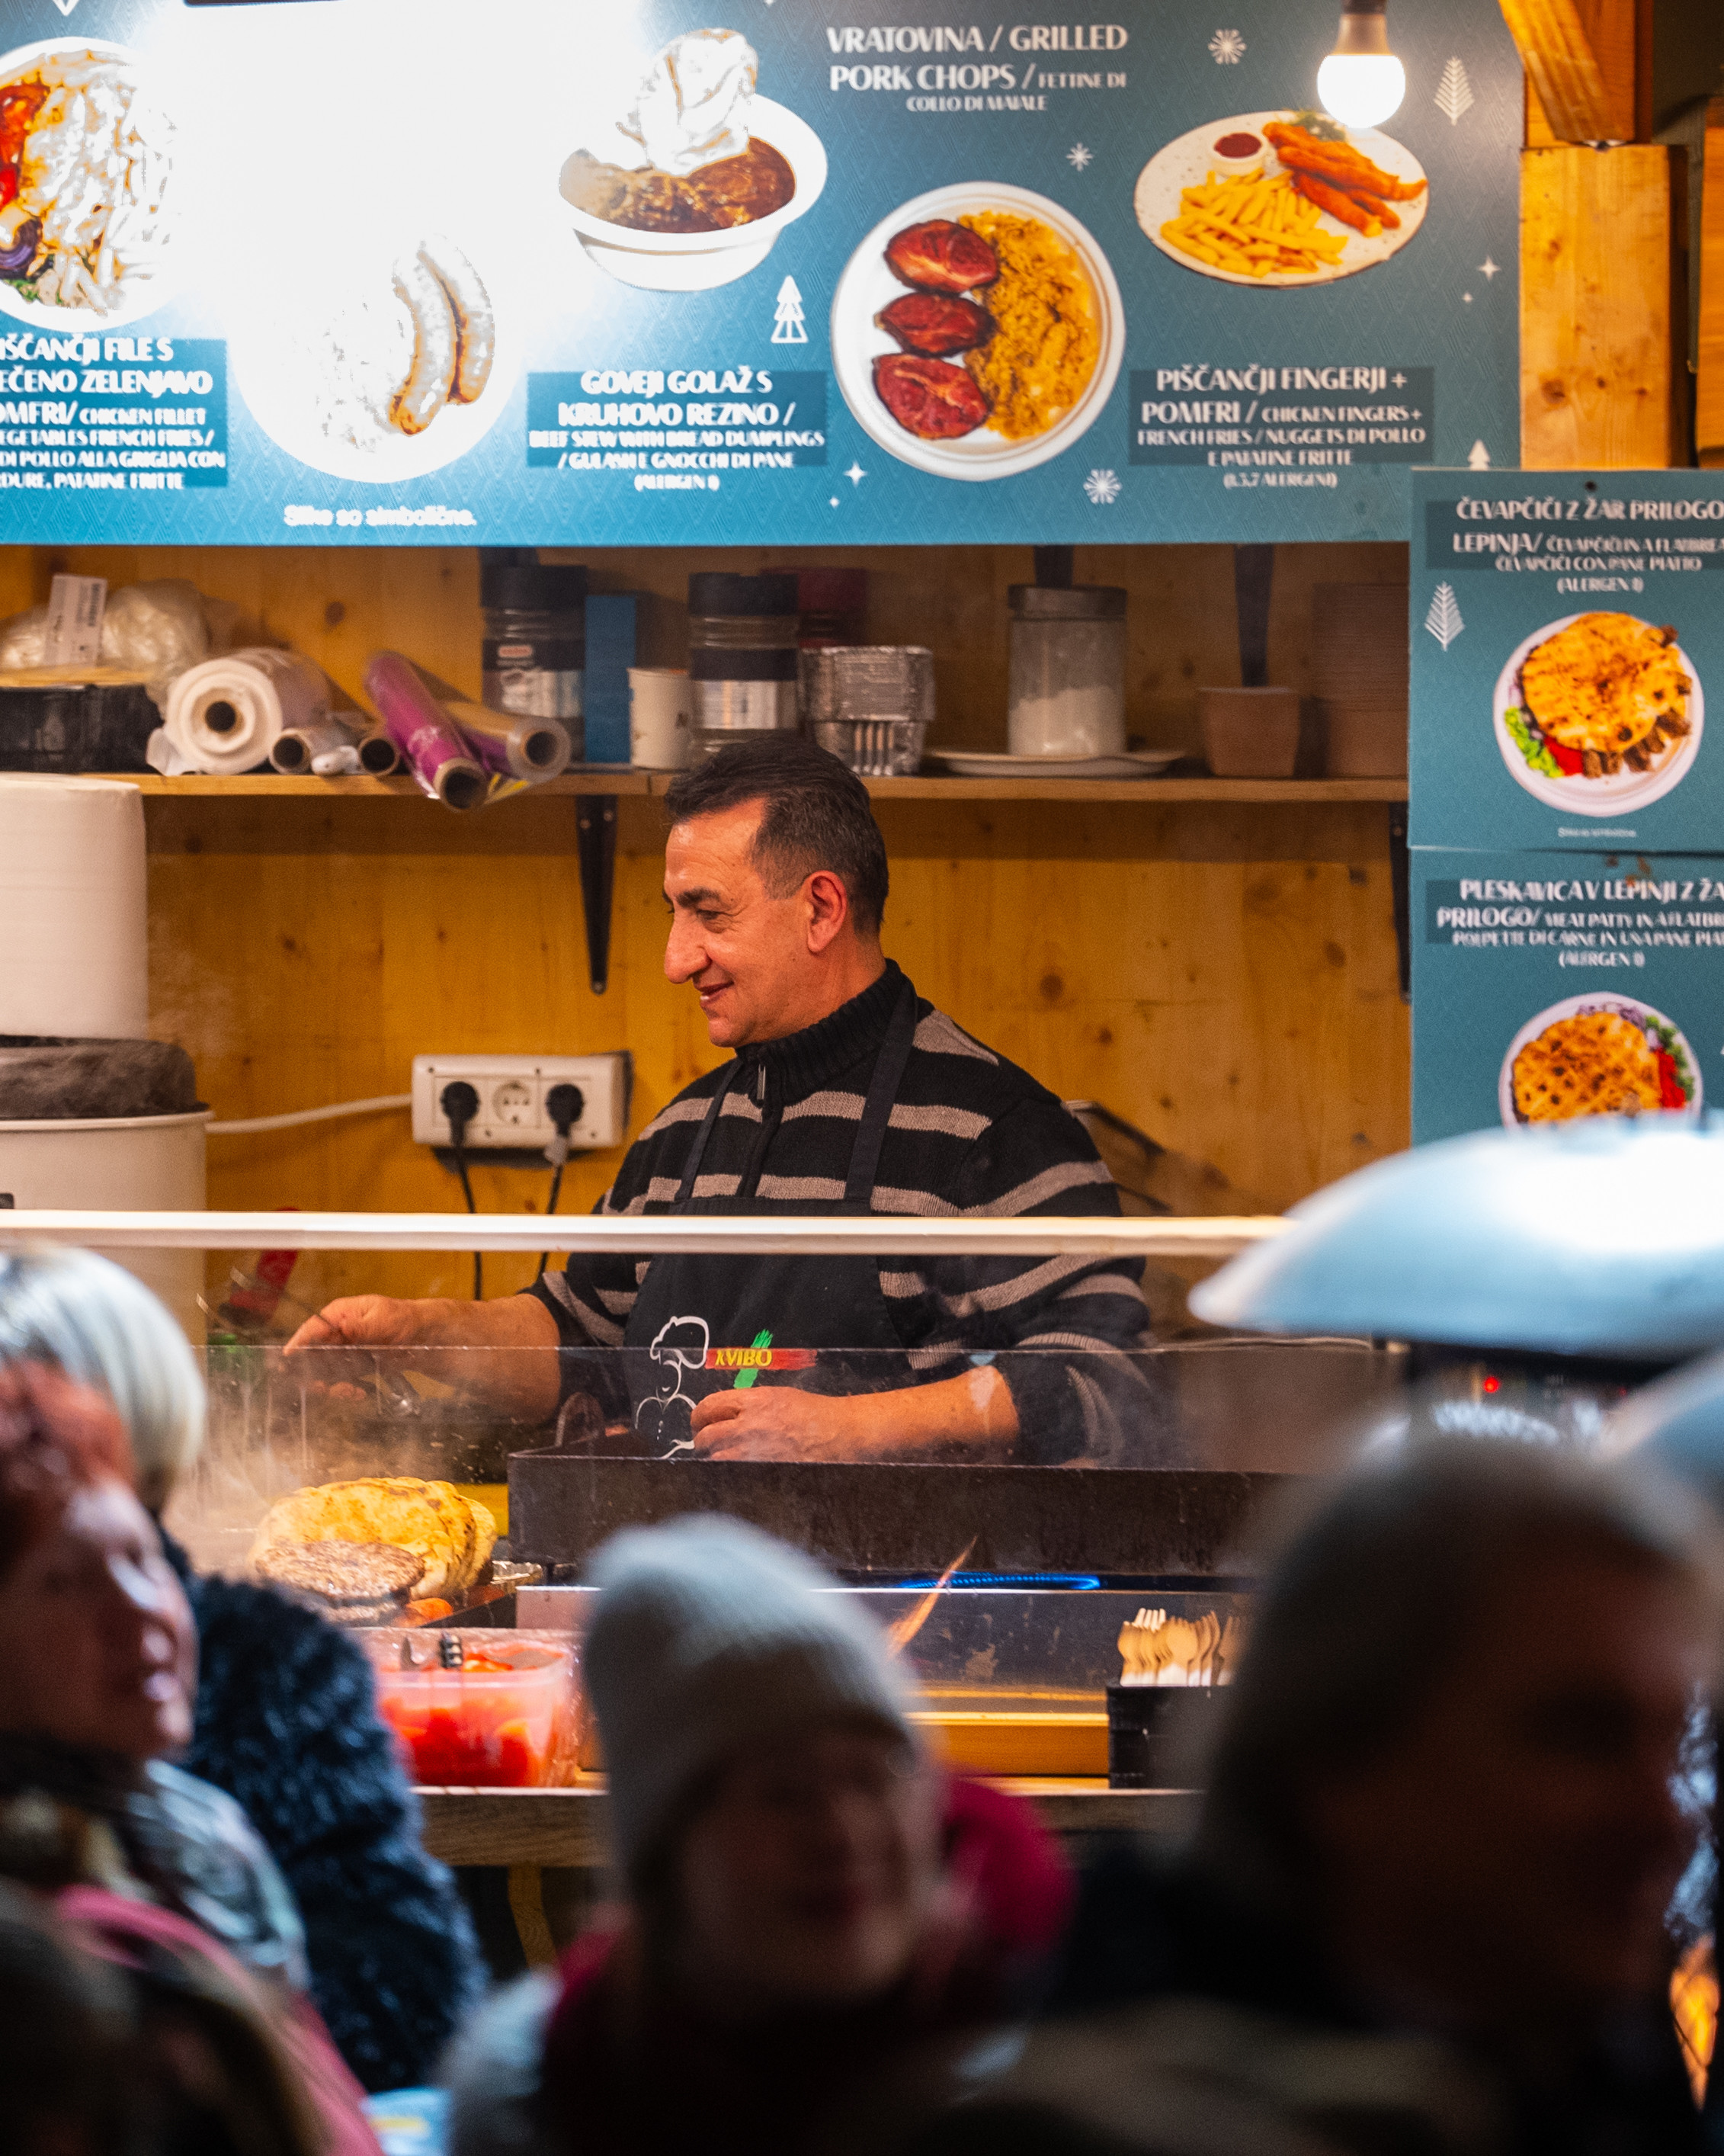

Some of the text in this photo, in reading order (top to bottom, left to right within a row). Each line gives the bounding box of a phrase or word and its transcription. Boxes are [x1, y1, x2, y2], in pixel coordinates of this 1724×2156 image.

[826, 26, 984, 53] VRATOVINA
[1008, 25, 1128, 51] GRILLED
[830, 65, 913, 91] PORK
[916, 64, 1017, 91] CHOPS
[1107, 72, 1126, 88] DI
[906, 95, 961, 111] COLLO
[964, 95, 983, 111] DI
[104, 337, 152, 361] FILE
[156, 337, 174, 361] S
[80, 370, 213, 398] ZELENJAVO
[581, 364, 772, 398] GOVEJI GOLAŽ S
[1156, 363, 1275, 394] PIŠČANČJI
[1280, 367, 1387, 394] FINGERJI
[558, 403, 683, 426] KRUHOVO
[686, 402, 779, 425] REZINO
[1142, 401, 1241, 424] POMFRI
[1261, 406, 1335, 423] CHICKEN
[1338, 406, 1409, 422] FINGERS
[1137, 429, 1204, 445] FRENCH
[1369, 428, 1426, 444] POLLO
[19, 451, 75, 467] POLLO
[1456, 496, 1724, 520] ČEVAPČIČI Z ŽAR PRILOGO
[1584, 881, 1600, 900] V
[1681, 881, 1694, 901] Z
